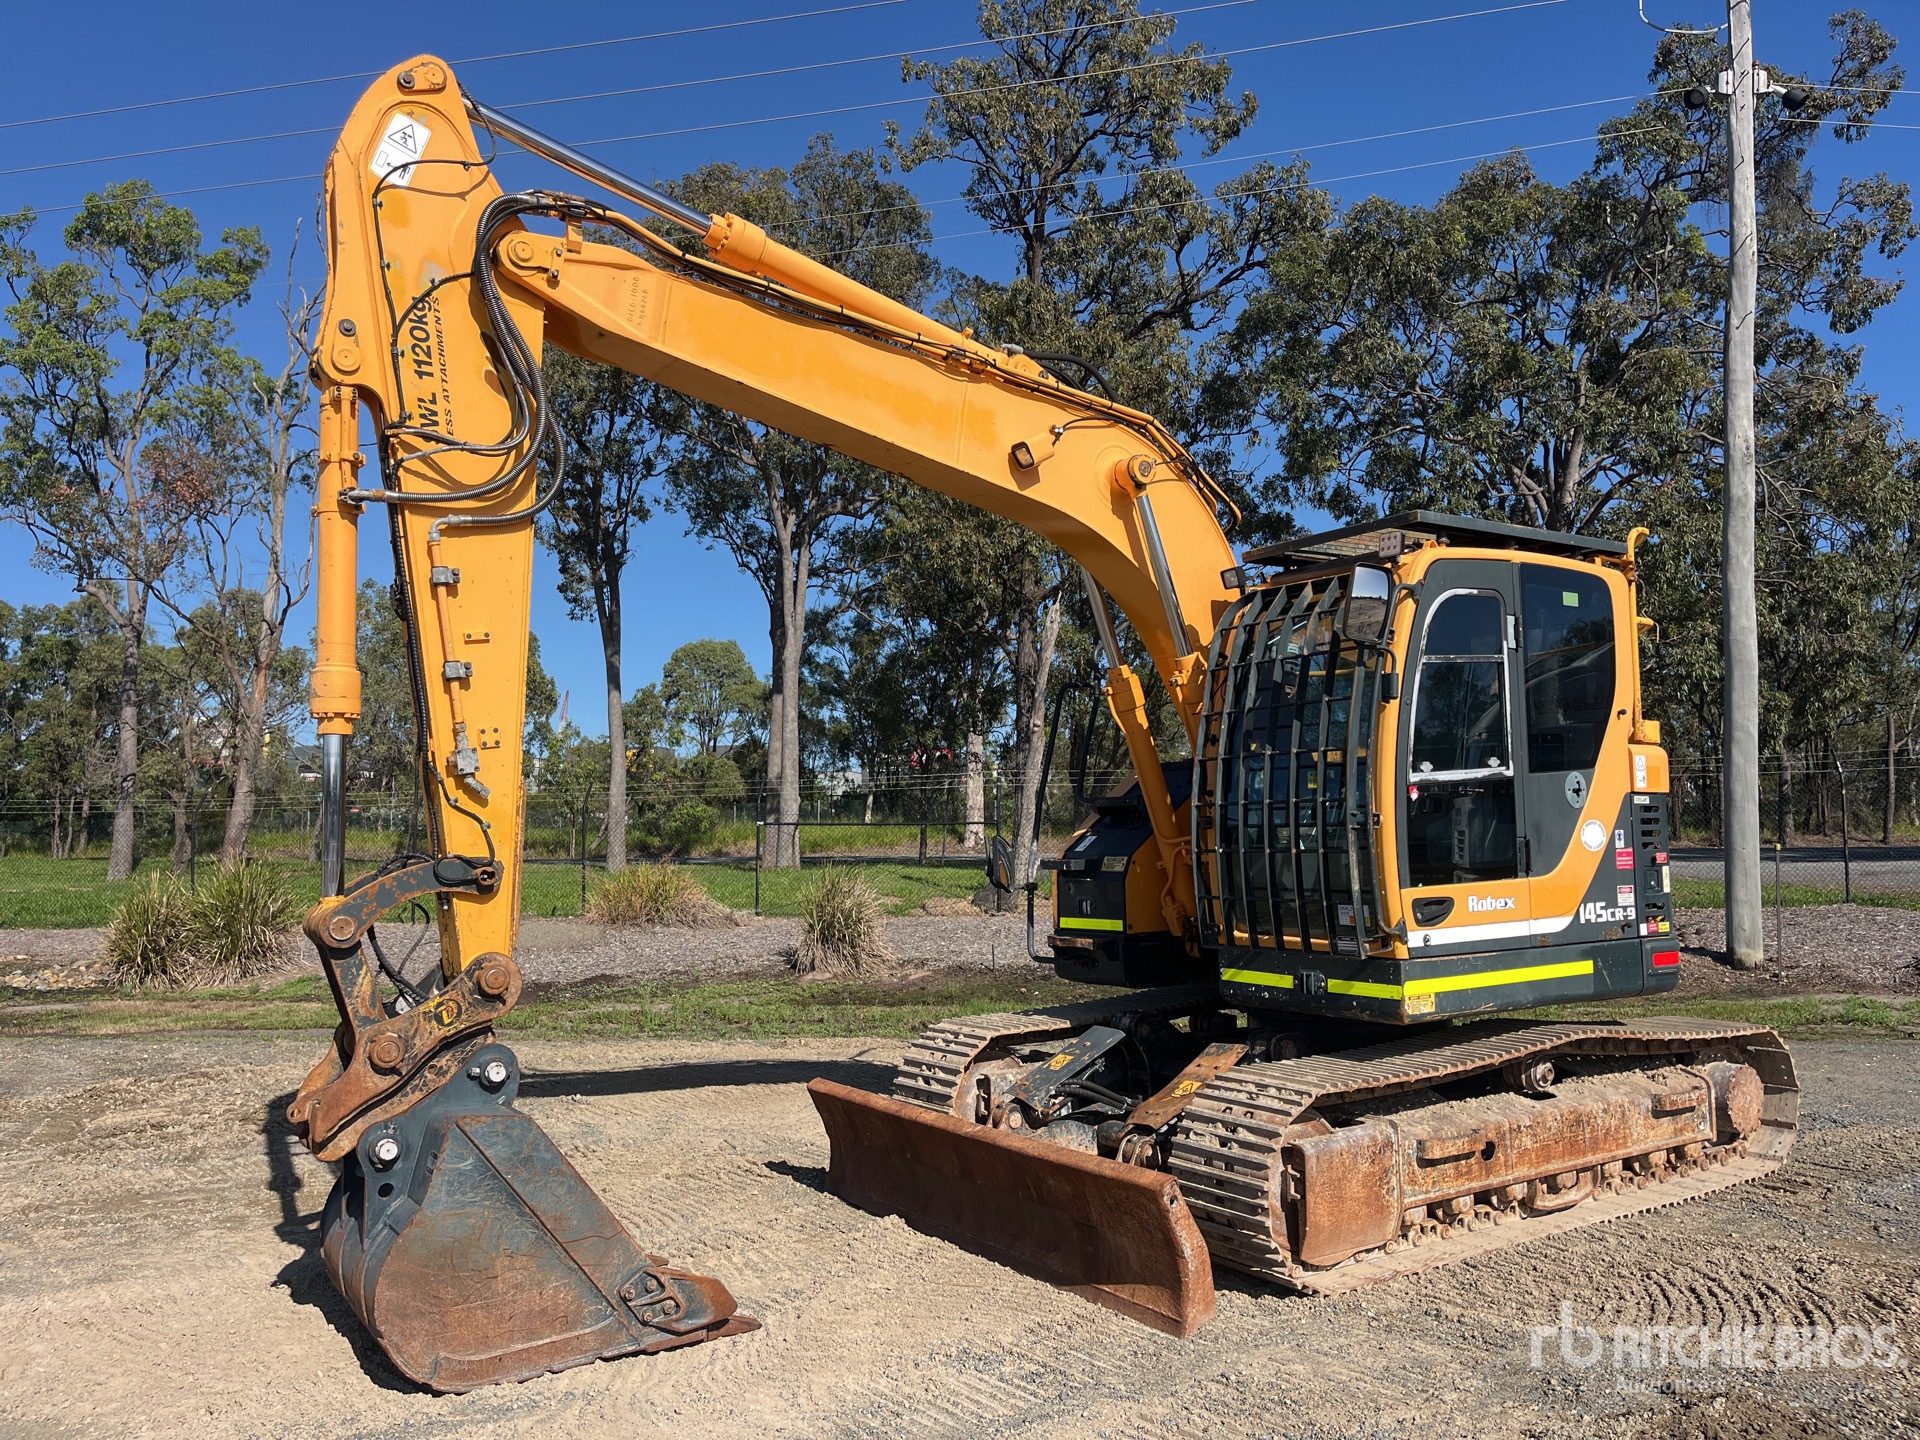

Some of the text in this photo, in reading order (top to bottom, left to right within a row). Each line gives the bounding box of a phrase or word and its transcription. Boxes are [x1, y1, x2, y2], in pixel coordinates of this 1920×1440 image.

[407, 295, 435, 380] 1120kg
[432, 296, 451, 404] ATTACHMENTS
[1468, 894, 1516, 912] Robex
